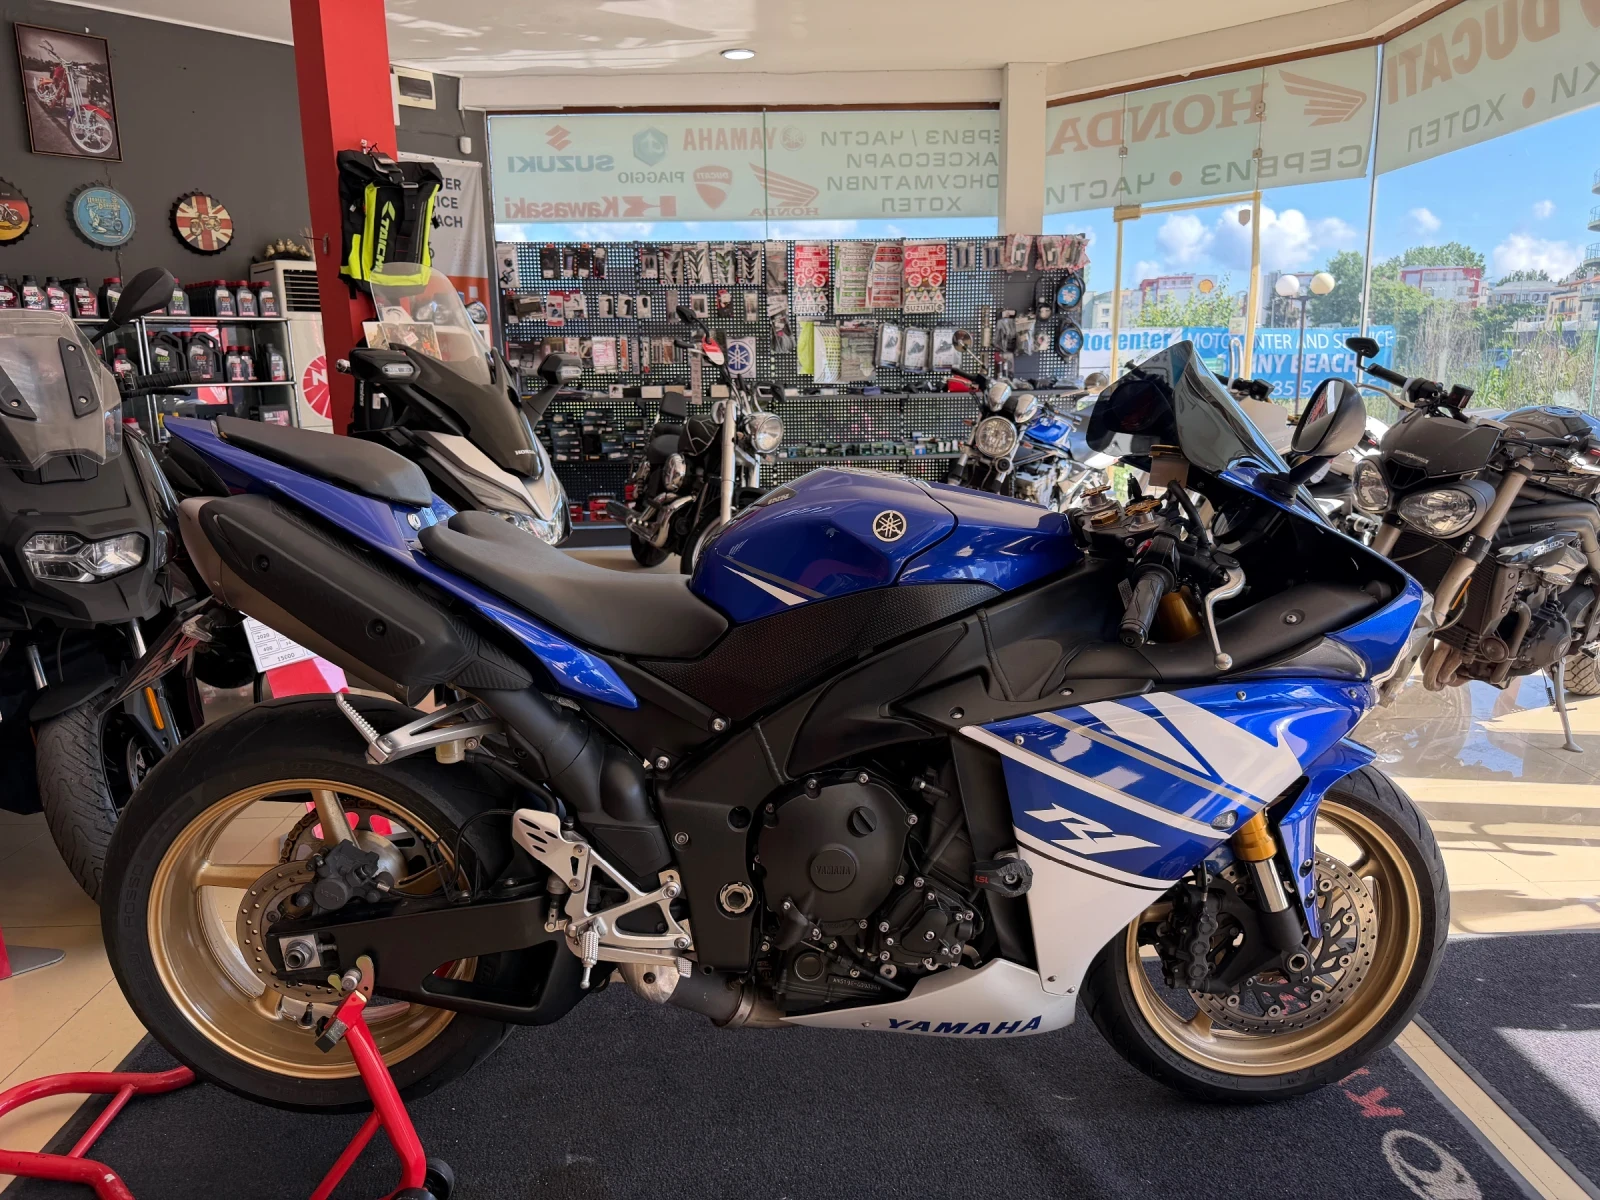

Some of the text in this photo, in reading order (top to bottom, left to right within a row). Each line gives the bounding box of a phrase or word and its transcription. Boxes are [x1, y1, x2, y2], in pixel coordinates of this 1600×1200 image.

[1290, 353, 1358, 374] BEACH
[815, 865, 851, 876] YAMAHA
[888, 1015, 1043, 1035] YAMAHA
